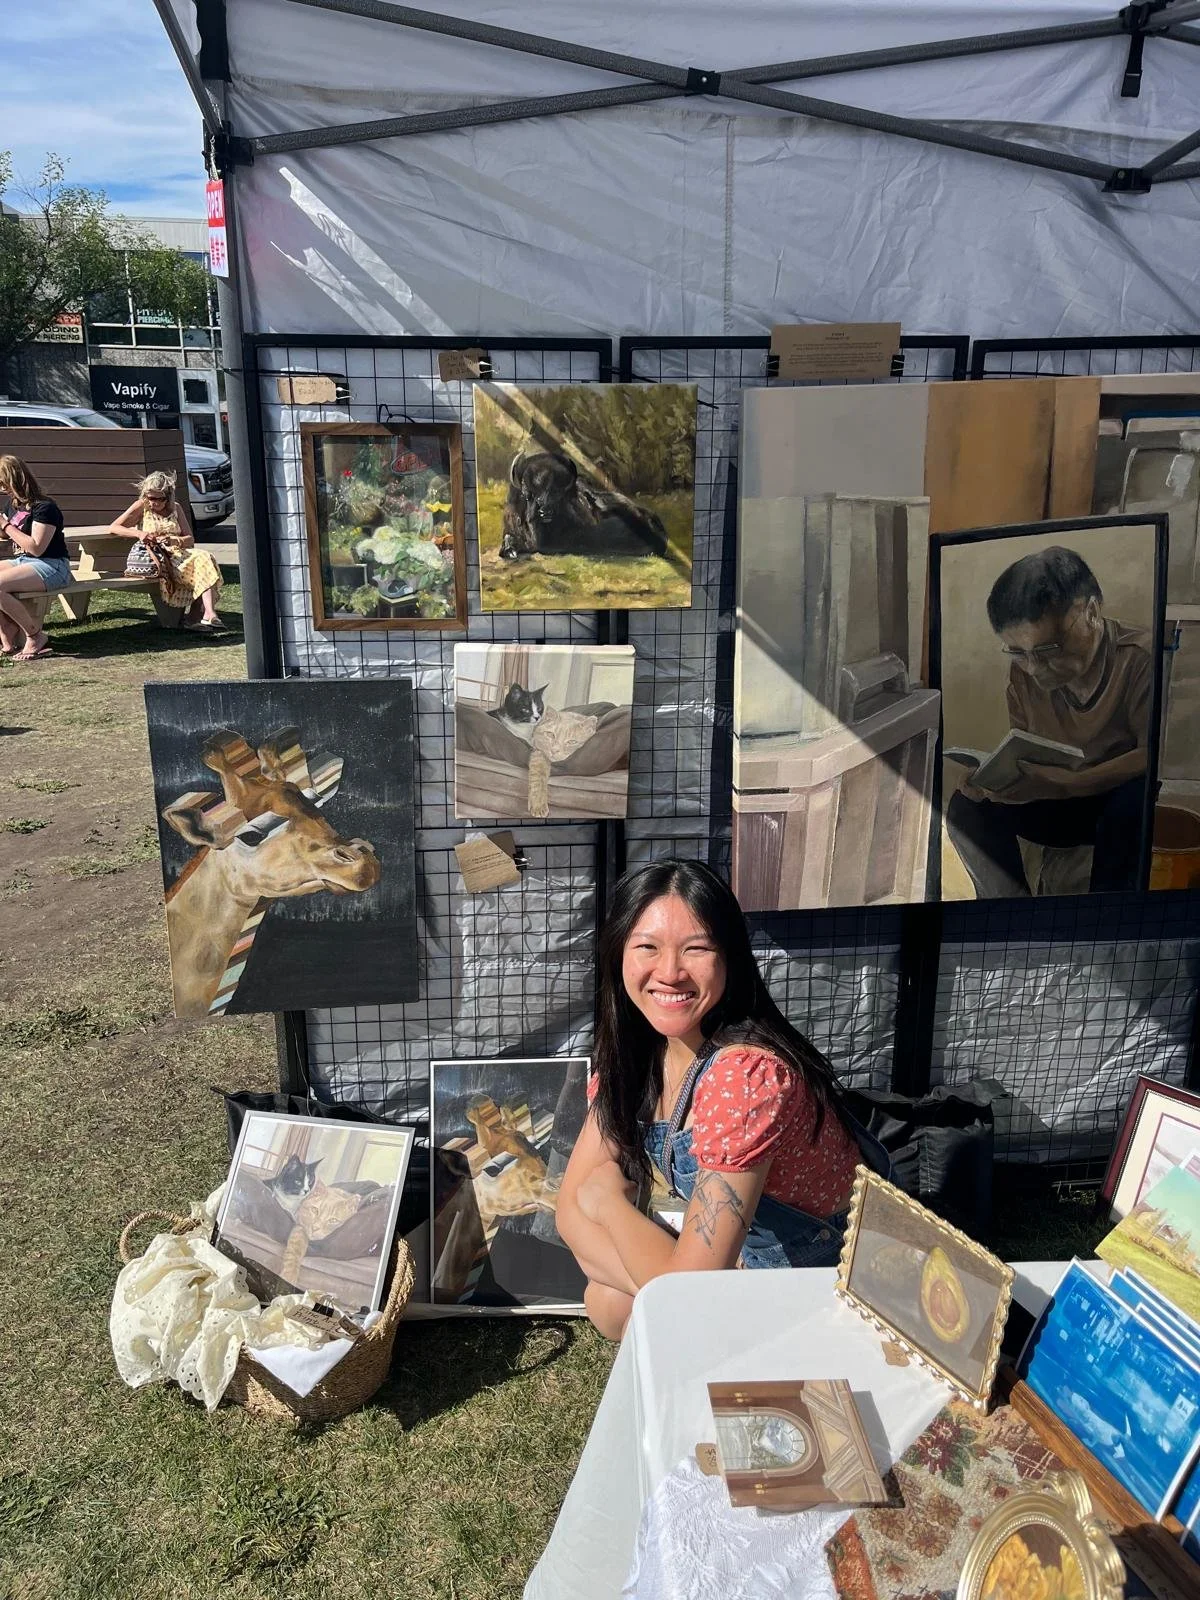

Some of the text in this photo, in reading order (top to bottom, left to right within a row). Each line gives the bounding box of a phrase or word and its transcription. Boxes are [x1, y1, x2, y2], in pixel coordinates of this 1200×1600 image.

[207, 189, 223, 218] OPEN
[111, 382, 157, 398] Vapify
[103, 402, 170, 411] Vape Smoke & Cigar
[299, 1304, 318, 1319] Fine
